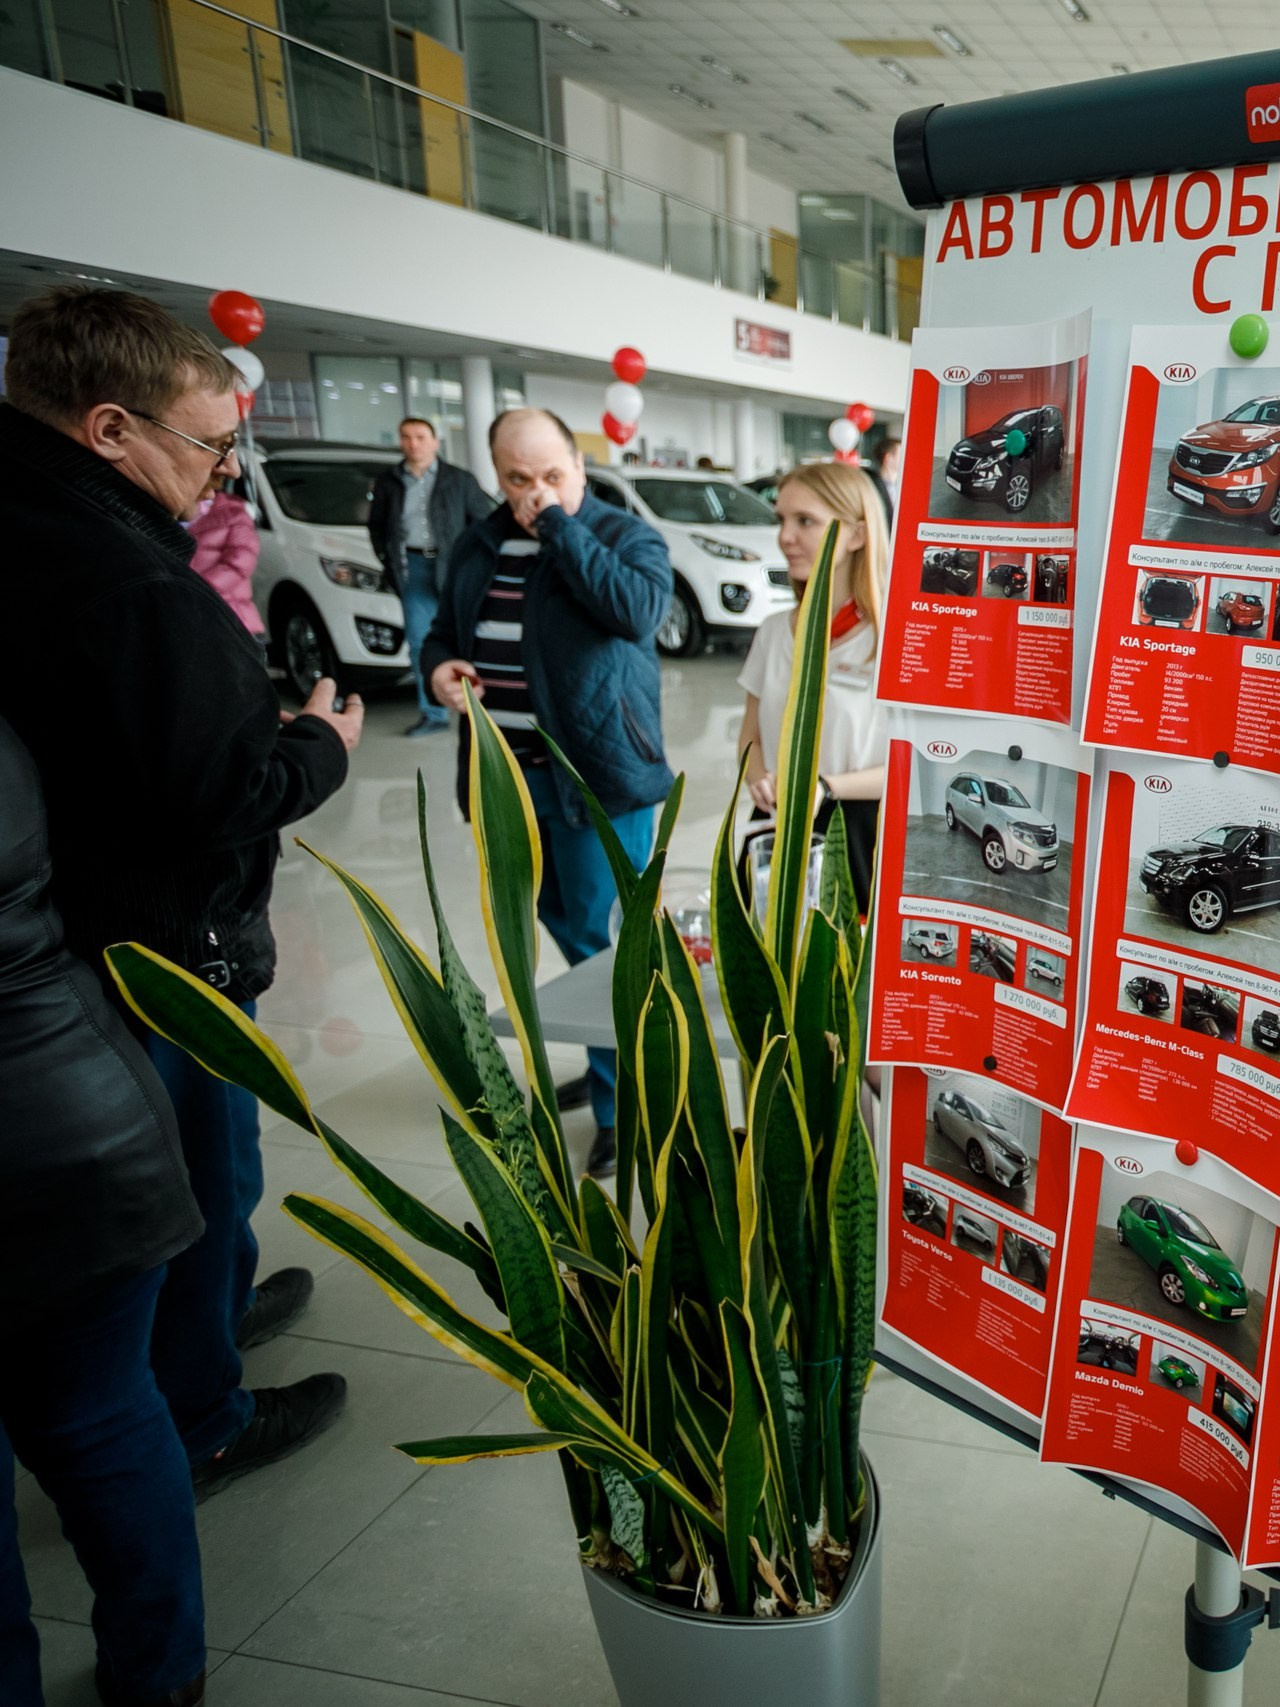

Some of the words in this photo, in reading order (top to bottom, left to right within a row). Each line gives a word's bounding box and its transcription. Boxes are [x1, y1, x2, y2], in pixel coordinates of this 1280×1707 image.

[1192, 246, 1236, 314] С
[1132, 553, 1178, 566] Консультант
[1180, 558, 1188, 567] по
[1190, 559, 1202, 567] а/м
[1210, 561, 1244, 572] пробегом:
[1246, 563, 1273, 574] Алексей
[912, 602, 929, 611] KIA
[932, 604, 977, 617] Sportage
[1026, 611, 1029, 620] 1
[1032, 612, 1043, 621] 150
[1046, 613, 1058, 623] 000
[1120, 636, 1140, 648] KIA
[1144, 639, 1196, 655] Sportage
[1256, 653, 1273, 664] 950
[903, 904, 944, 915] Консультант
[1001, 921, 1023, 934] Алексей
[900, 969, 918, 980] KIA
[921, 971, 961, 986] Sorento
[1119, 946, 1158, 961] Консультант
[1159, 956, 1166, 964] по
[1184, 962, 1215, 977] пробегом:
[1217, 971, 1243, 986] Алексей
[1003, 990, 1007, 999] 1
[1010, 991, 1024, 1004] 270
[1026, 997, 1041, 1011] 000
[1043, 1004, 1059, 1019] руб.
[1096, 1024, 1166, 1049] Mercedes-Benz
[1169, 1043, 1204, 1060] M-Class
[1230, 1062, 1248, 1077] 785
[1249, 1069, 1265, 1086] 000
[902, 1230, 929, 1248] Toyota
[930, 1244, 953, 1262] Verso
[994, 1276, 1006, 1288] 135
[1008, 1282, 1022, 1298] 000
[1075, 1371, 1109, 1386] Mazda
[1112, 1379, 1144, 1396] Demio
[1200, 1418, 1214, 1433] 415
[1215, 1429, 1230, 1446] 000
[1230, 1442, 1245, 1461] руб.
